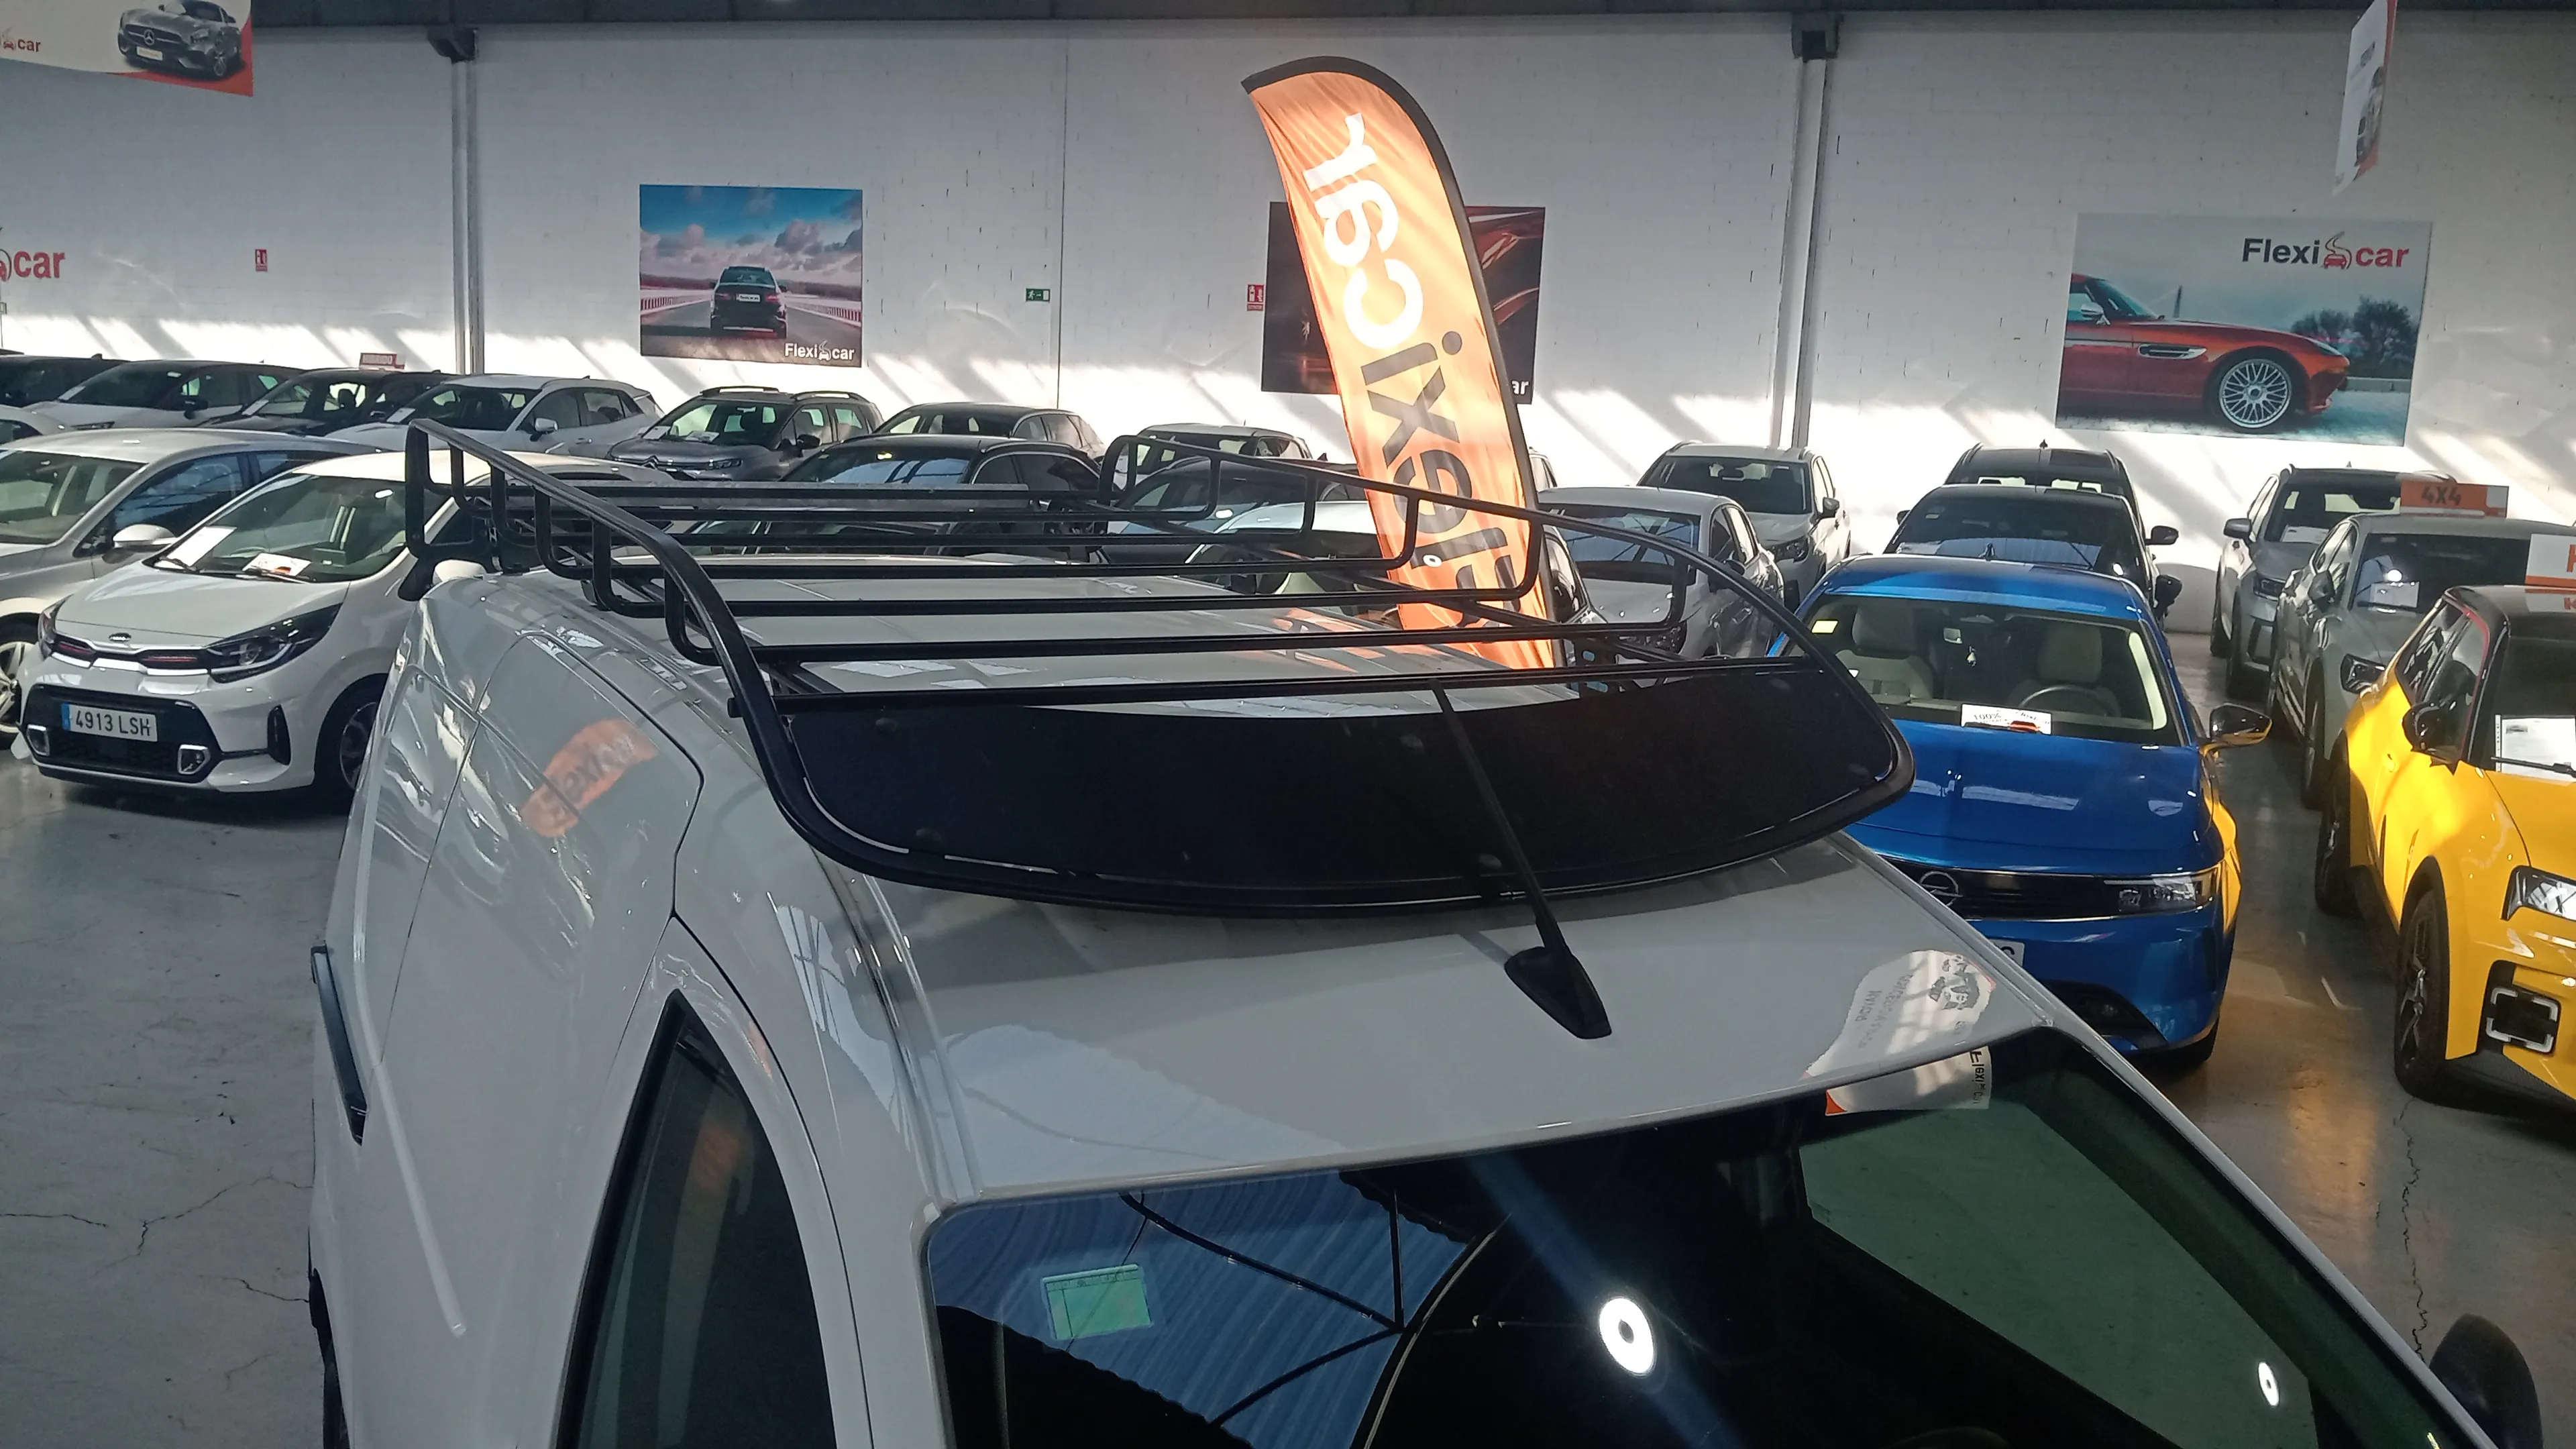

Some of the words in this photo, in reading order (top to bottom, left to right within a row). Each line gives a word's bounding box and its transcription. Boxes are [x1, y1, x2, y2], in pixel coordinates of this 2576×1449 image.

[17, 38, 41, 52] car
[13, 250, 66, 279] car
[1511, 380, 1529, 395] ar
[75, 710, 113, 732] 4913
[118, 715, 150, 737] LSH
